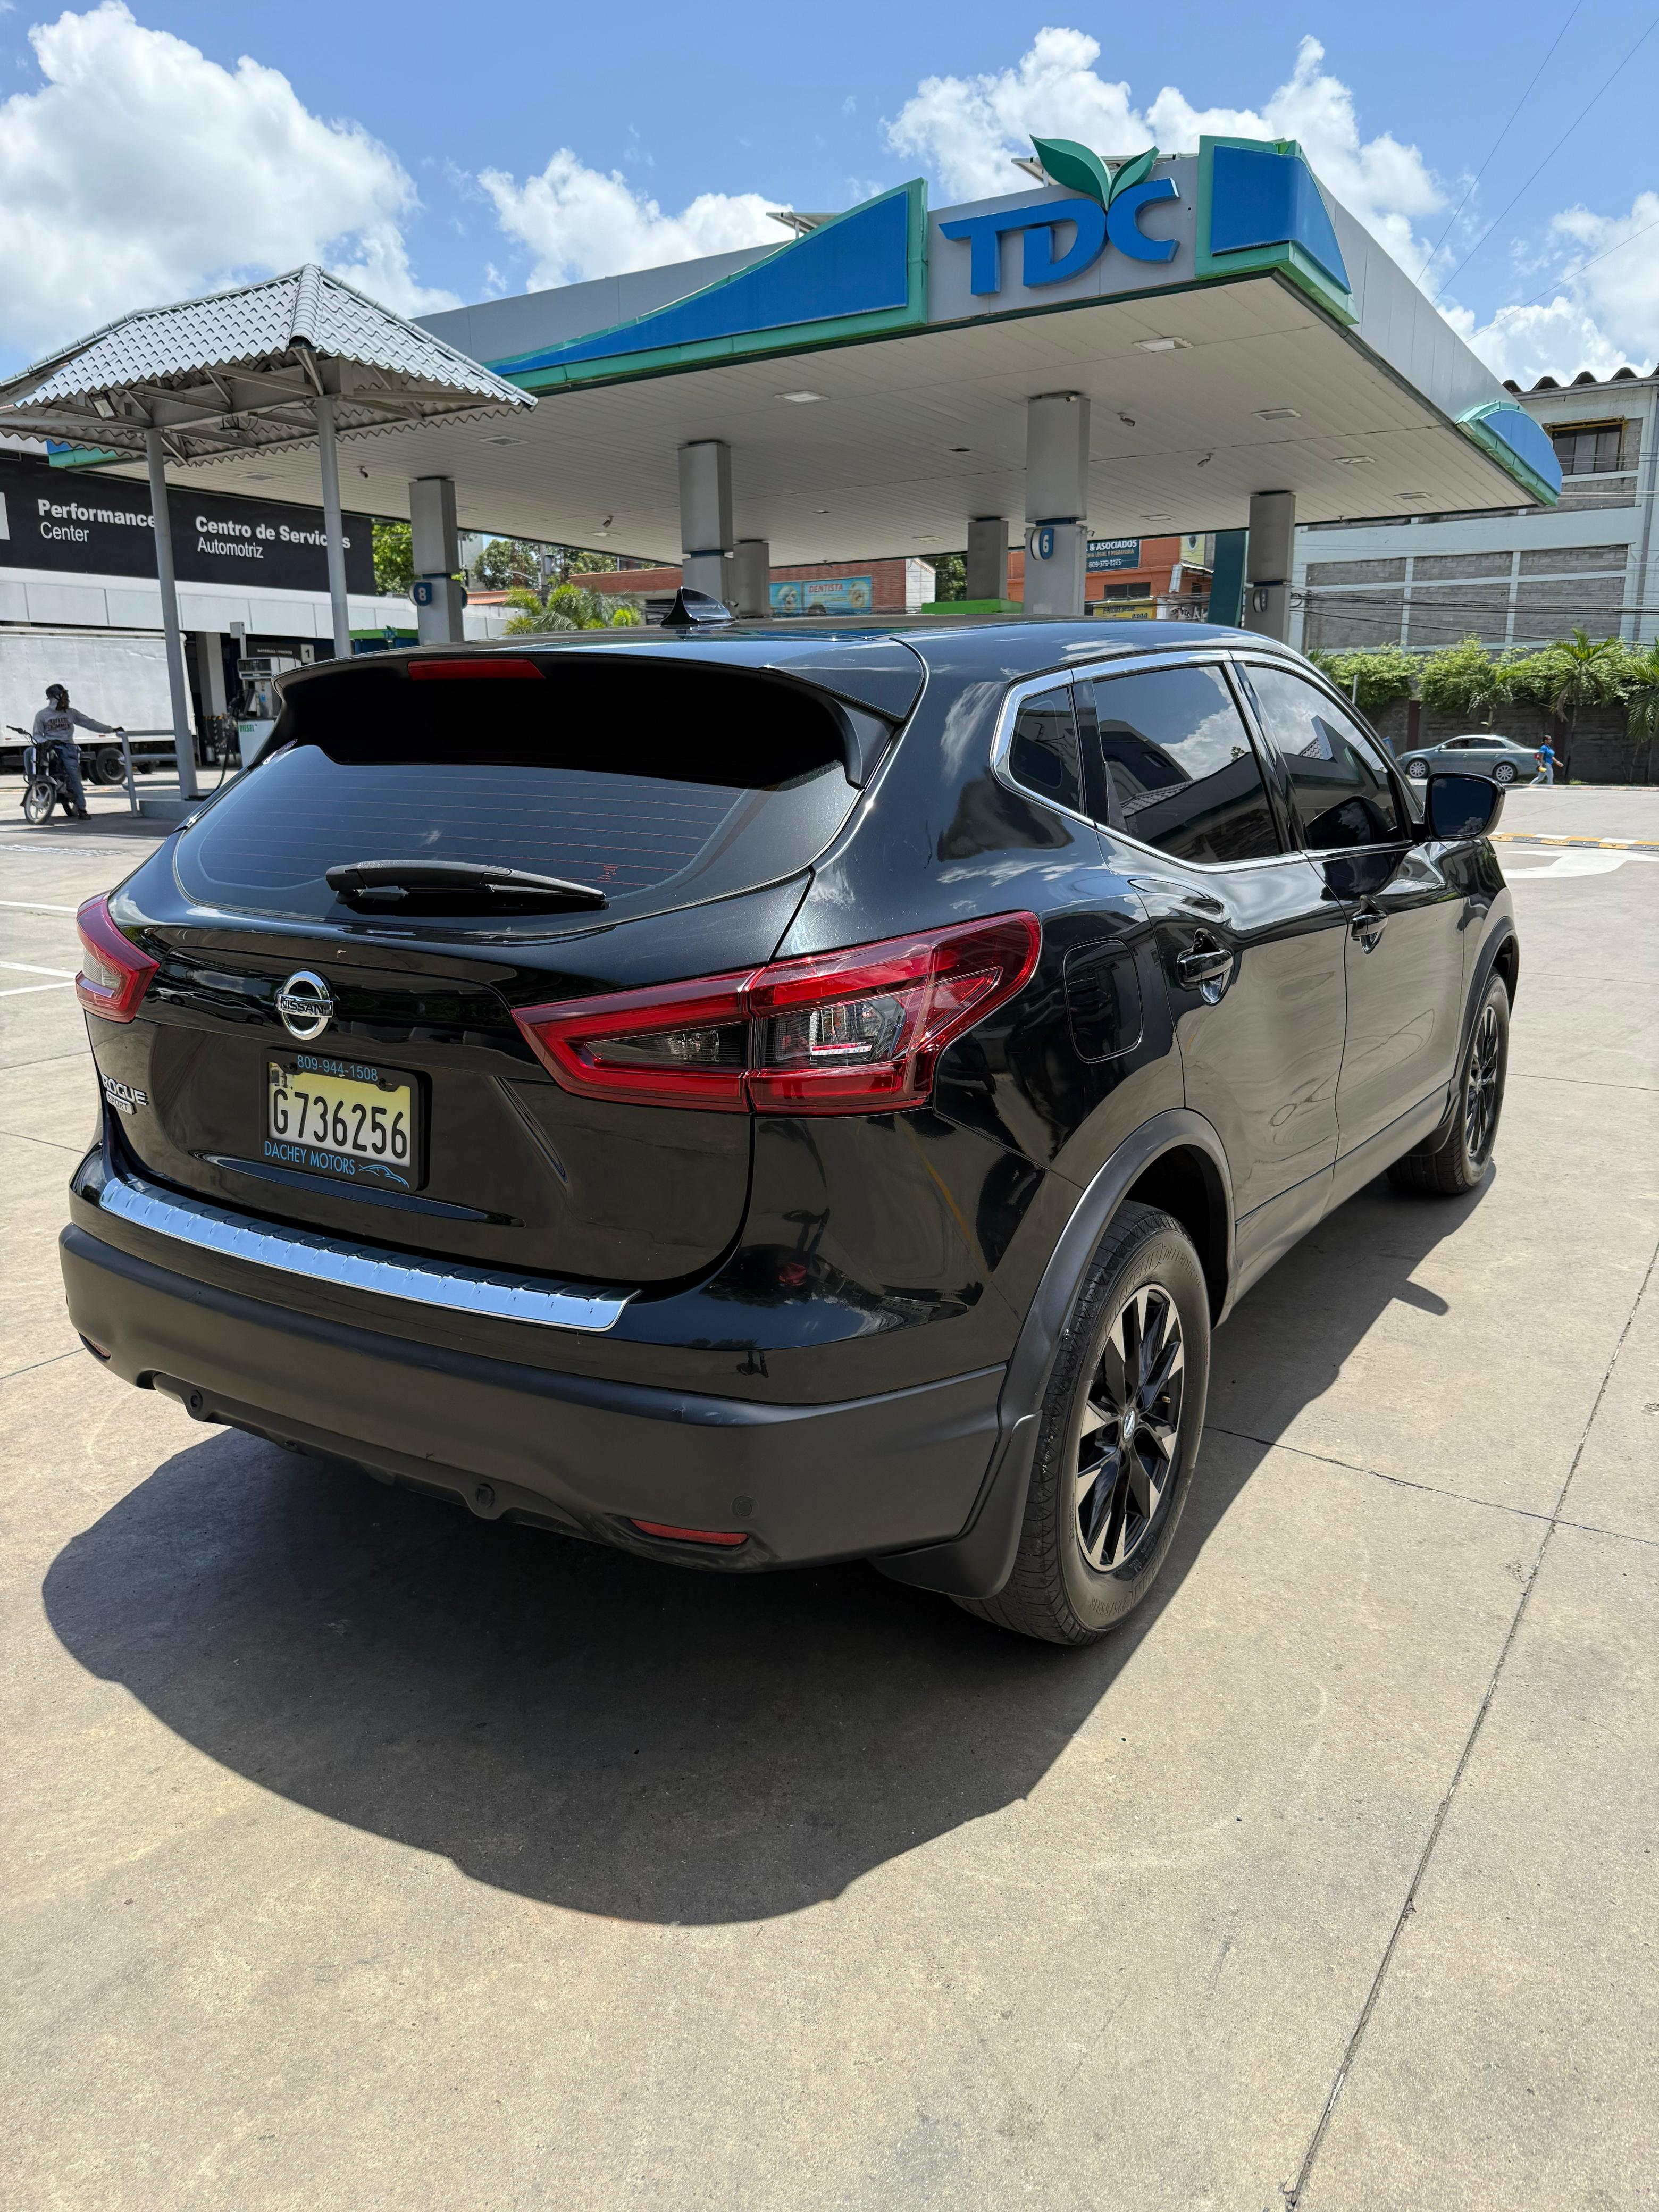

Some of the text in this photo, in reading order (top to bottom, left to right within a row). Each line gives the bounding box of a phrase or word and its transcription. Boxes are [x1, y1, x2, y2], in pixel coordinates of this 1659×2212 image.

[938, 177, 1180, 296] TDC
[37, 499, 155, 528] Performance
[40, 521, 89, 542] Center
[195, 515, 351, 549] Centro de Servics
[197, 536, 264, 558] Automotriz
[1043, 534, 1049, 554] 6
[1089, 540, 1137, 551] & ASOCIADOS
[418, 587, 427, 601] 8
[808, 583, 843, 593] DENTISTA
[305, 649, 311, 658] 1
[239, 724, 255, 733] DIESEL
[280, 998, 324, 1016] NISSAN
[297, 1054, 378, 1082] 809-944-1508
[101, 1073, 148, 1106] ROGUE
[108, 1094, 129, 1112] SPORT
[273, 1088, 407, 1159] G736256
[265, 1140, 355, 1175] DACHEY MOTORS
